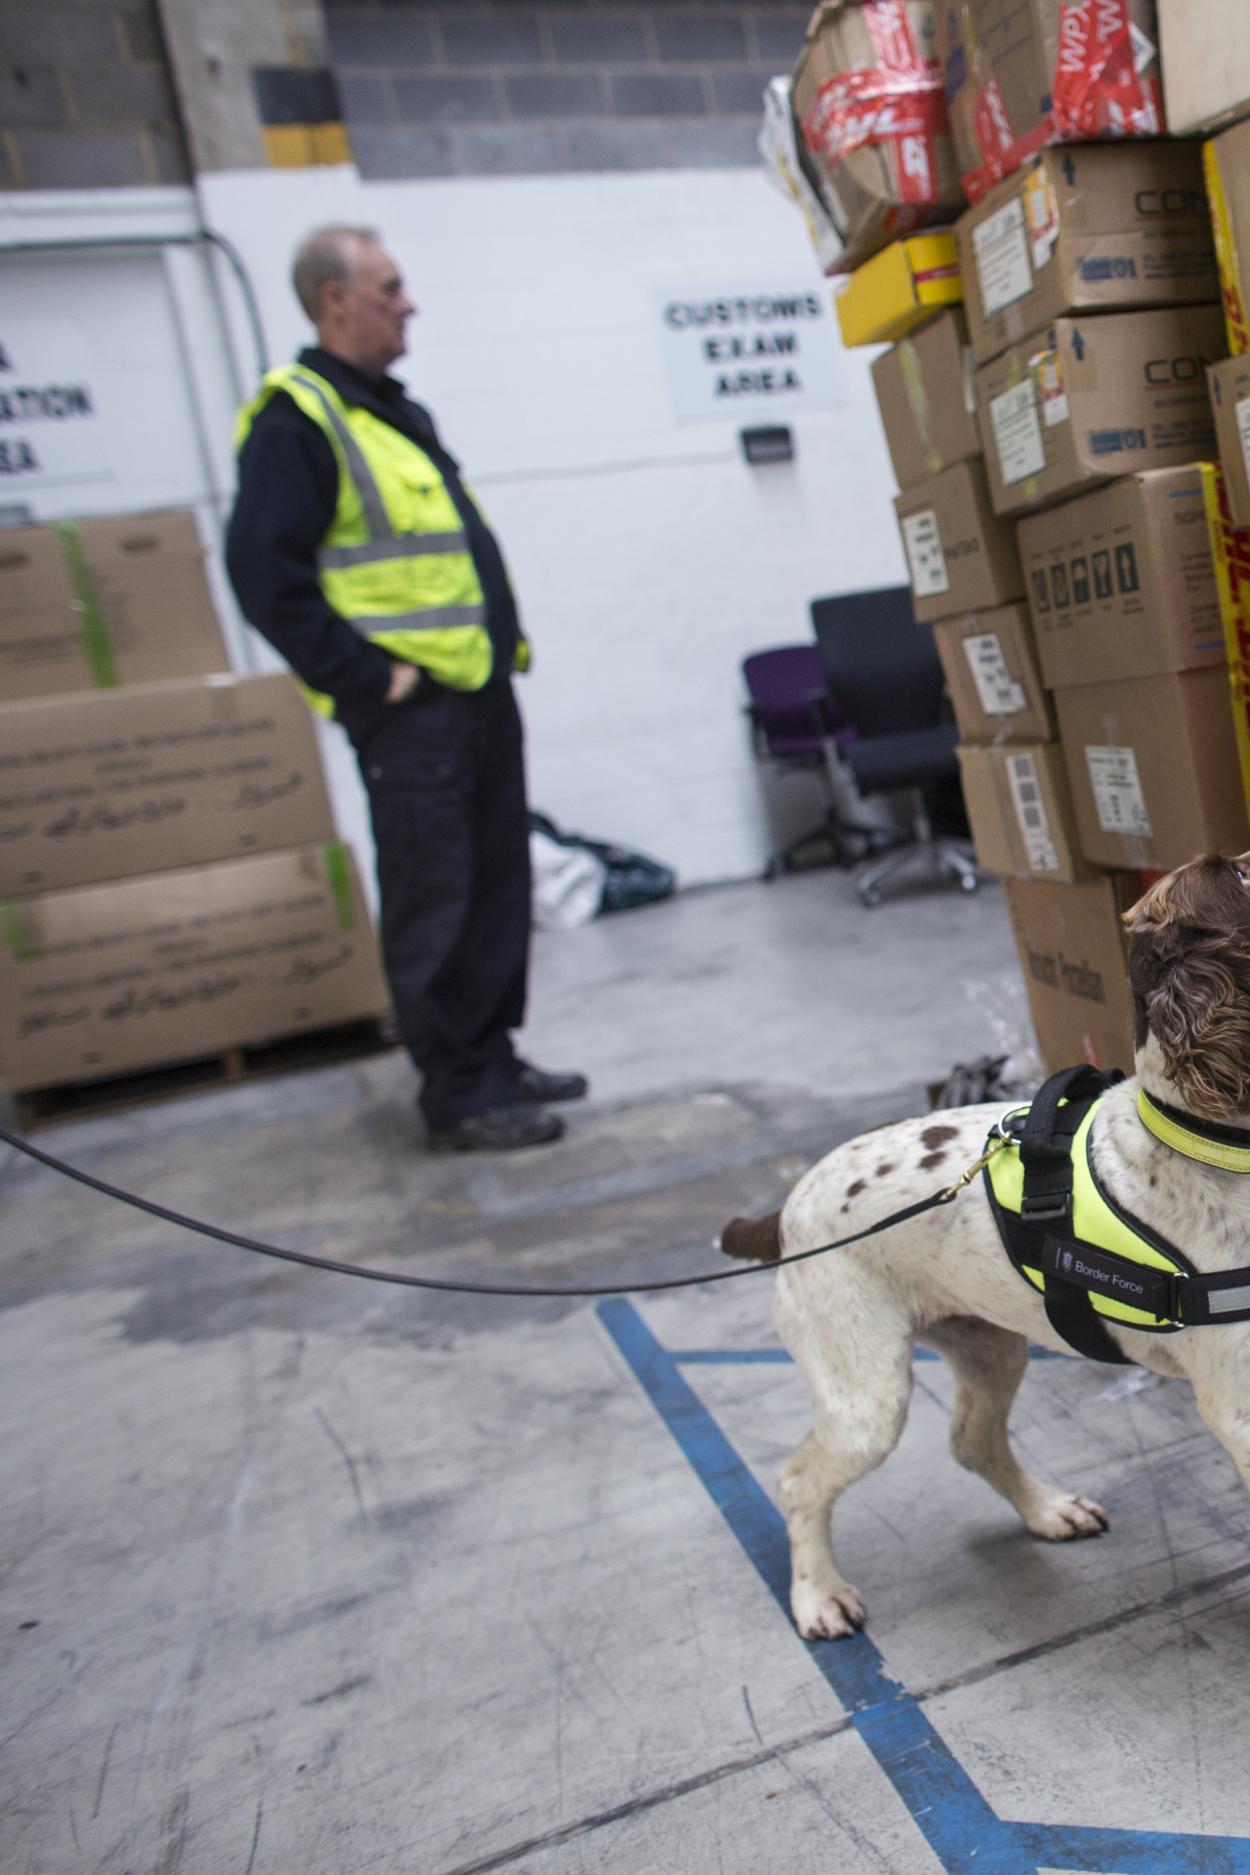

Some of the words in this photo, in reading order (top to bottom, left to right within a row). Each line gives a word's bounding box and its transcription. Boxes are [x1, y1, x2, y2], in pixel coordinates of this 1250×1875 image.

[665, 292, 822, 330] CUSTOMS
[704, 333, 797, 363] EXAM
[717, 368, 802, 398] AREA
[1075, 1260, 1111, 1283] Border
[1111, 1274, 1145, 1295] Force
